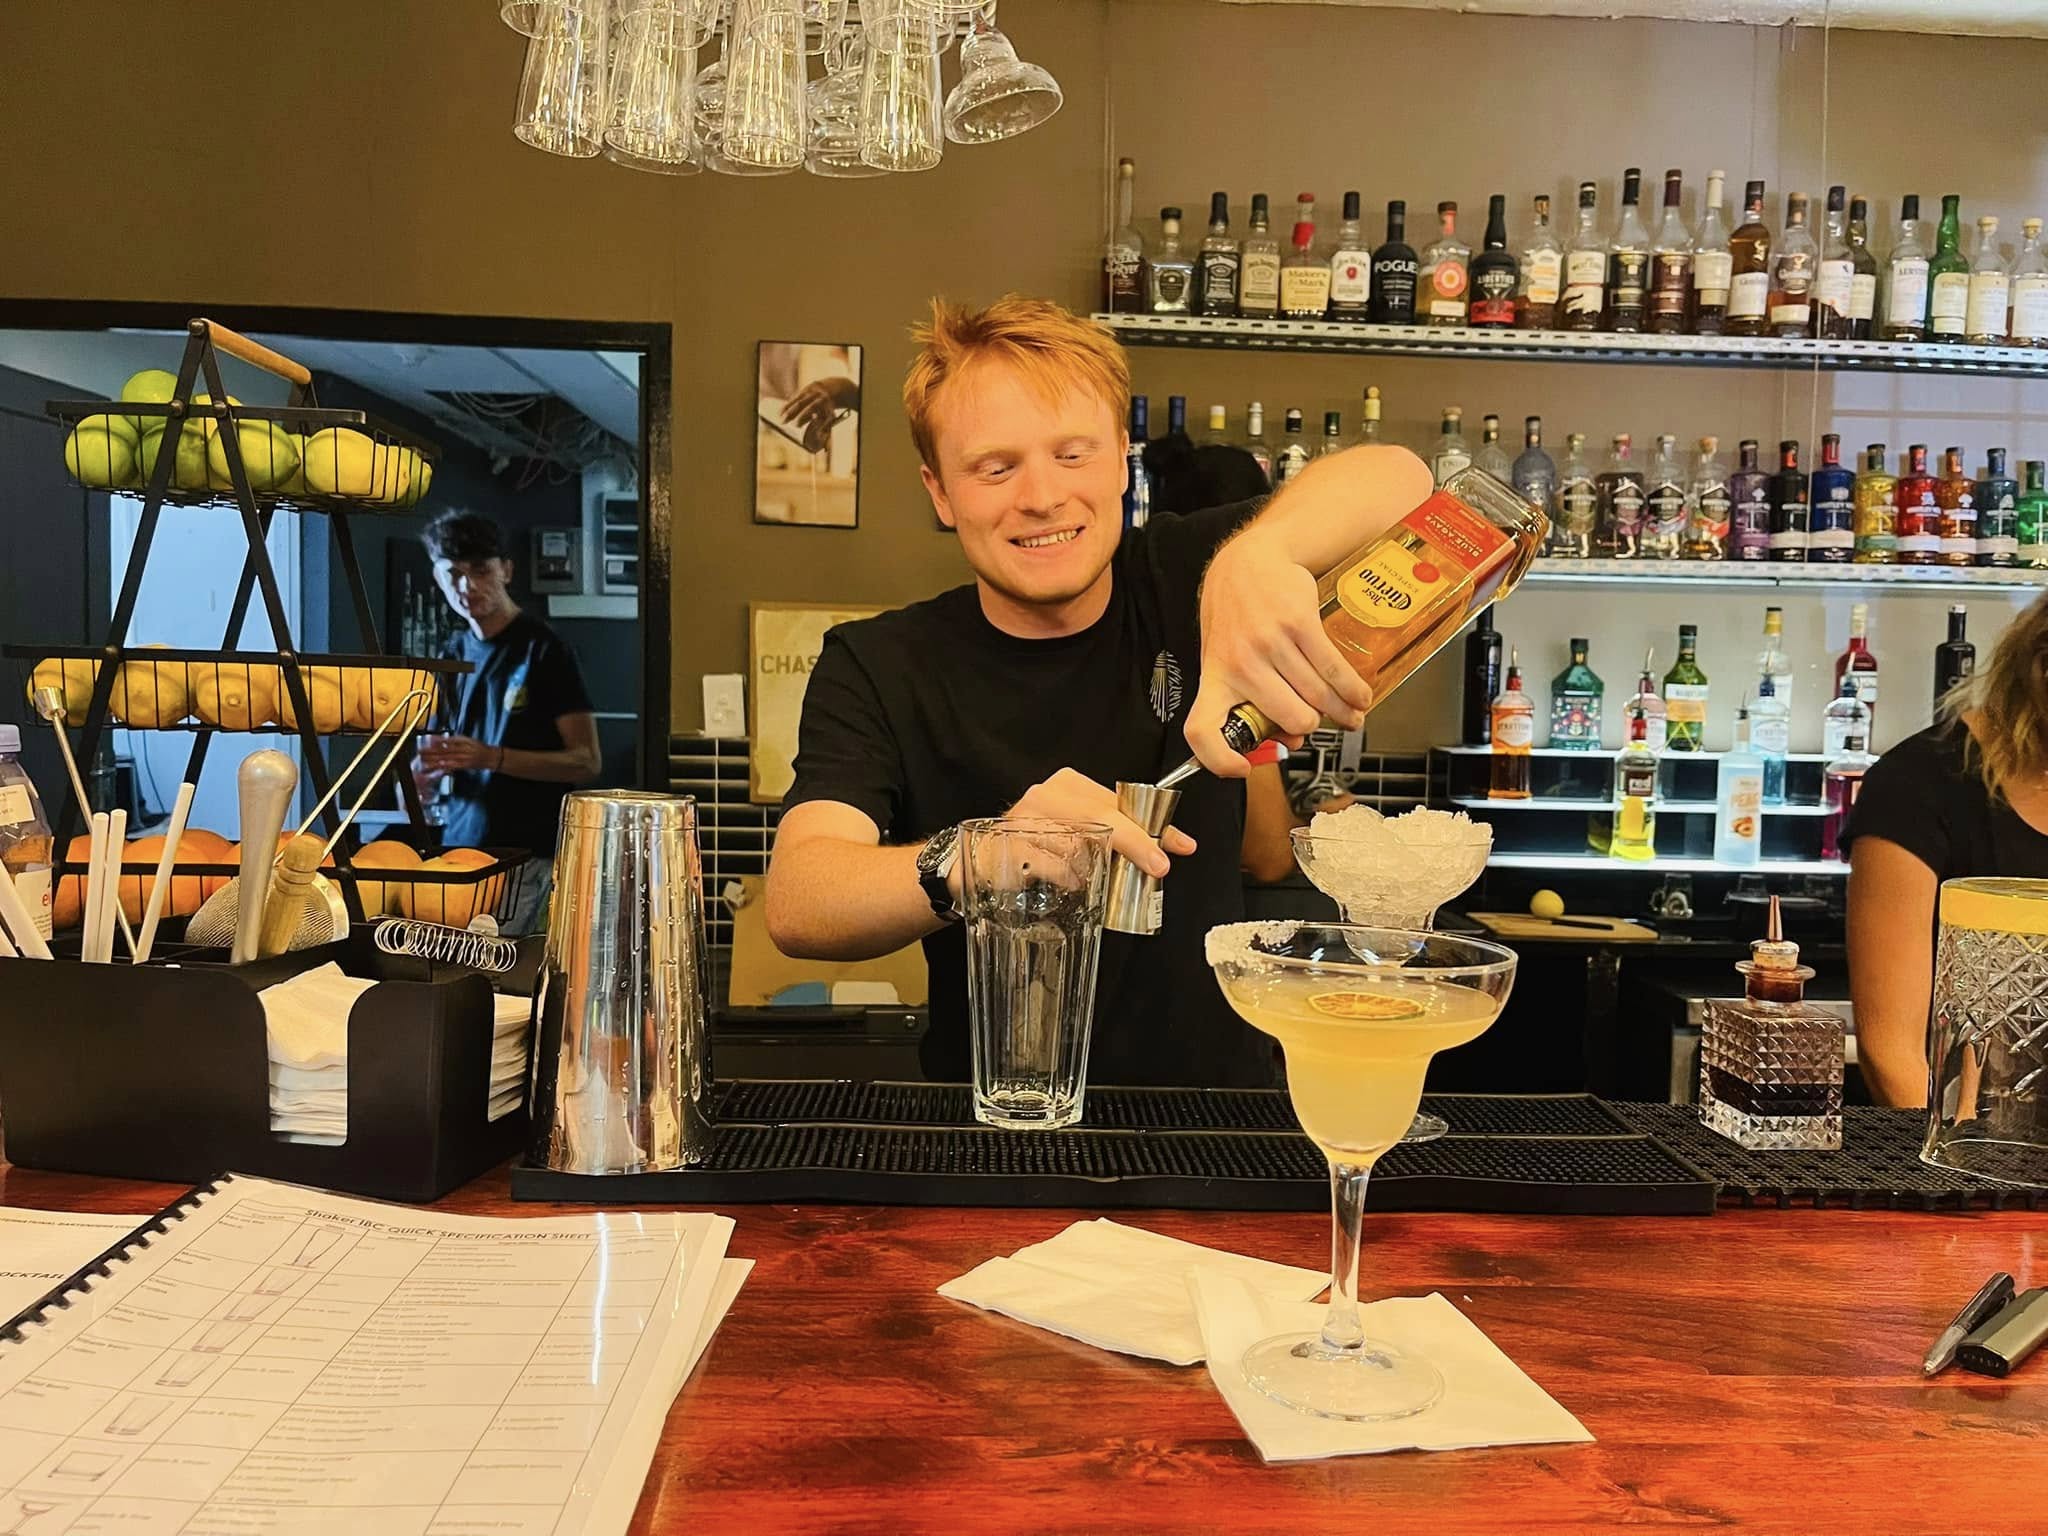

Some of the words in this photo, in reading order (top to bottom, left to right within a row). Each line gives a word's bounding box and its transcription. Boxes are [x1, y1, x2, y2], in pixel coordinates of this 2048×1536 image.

[1424, 514, 1455, 538] AGAVE
[1455, 538, 1480, 558] BLUE
[1358, 568, 1412, 610] Cuervo
[304, 1208, 355, 1225] Shaker
[388, 1226, 437, 1236] QUICK
[439, 1231, 548, 1240] SPECIFICATION
[551, 1232, 592, 1240] SHEET
